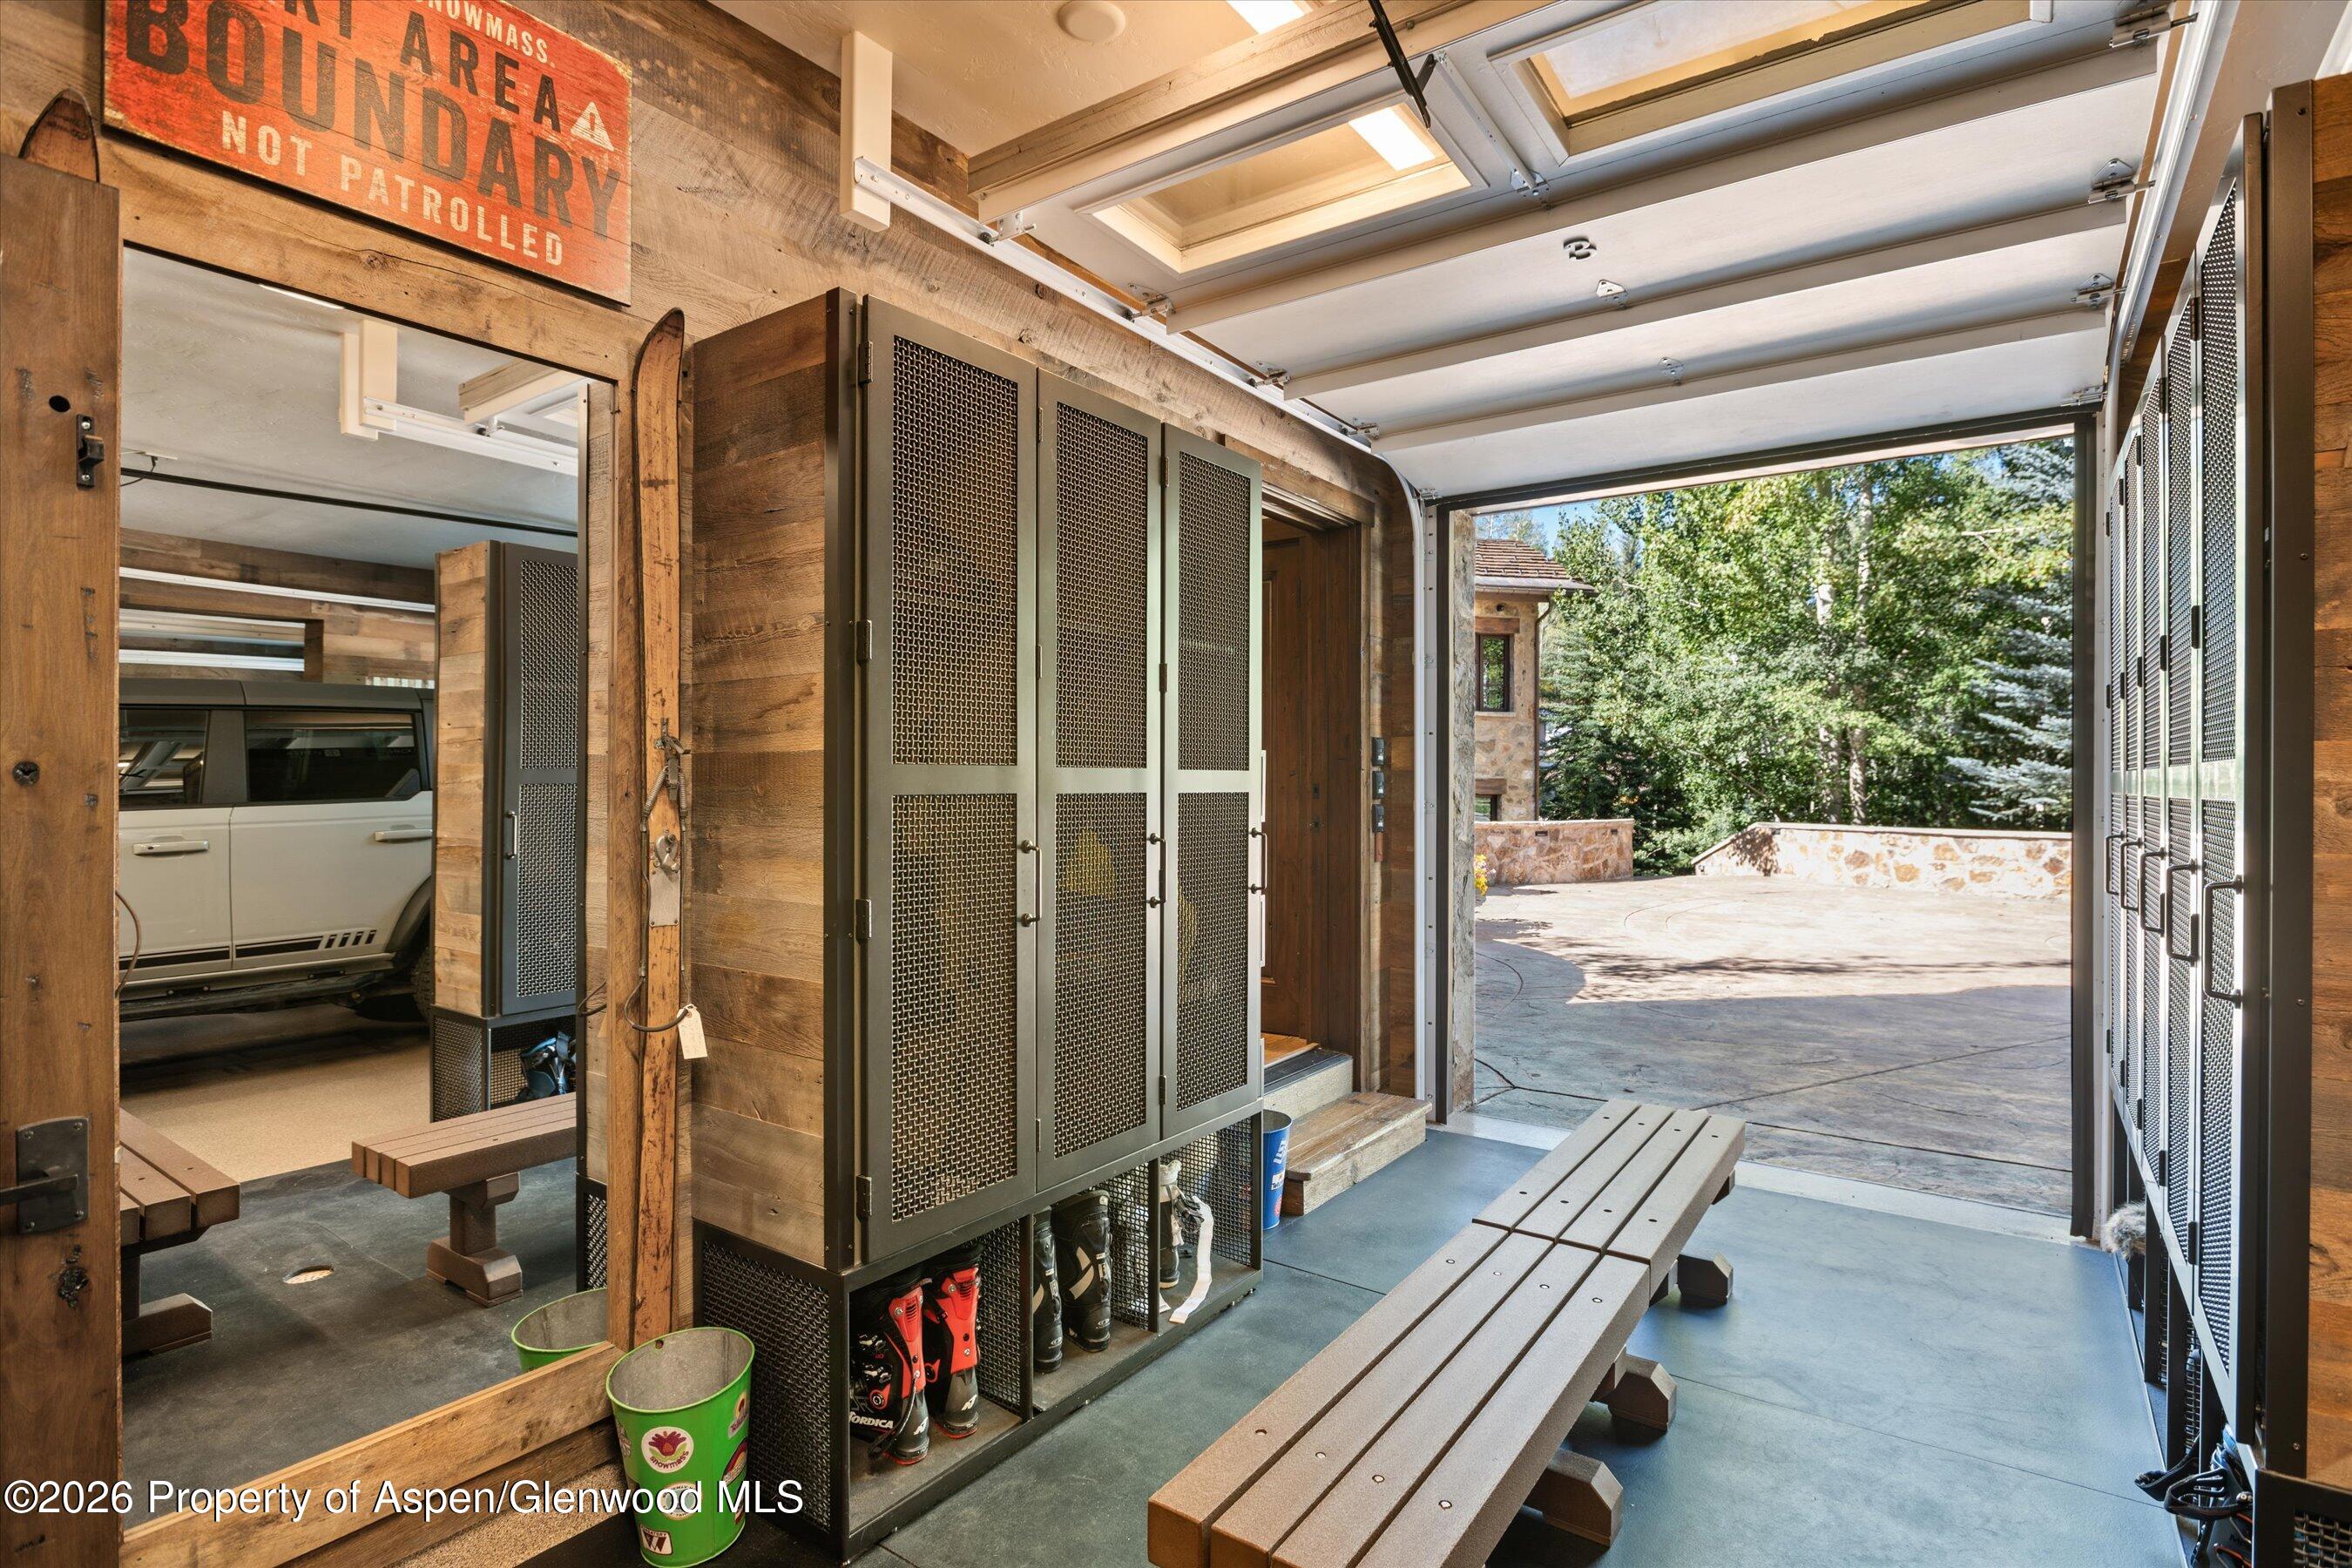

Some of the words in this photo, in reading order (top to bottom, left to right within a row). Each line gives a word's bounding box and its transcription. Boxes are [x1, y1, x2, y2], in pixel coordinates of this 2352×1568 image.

[400, 10, 561, 133] AREA
[415, 0, 557, 68] OWMASS.
[125, 0, 622, 243] BOUNDARY
[220, 110, 313, 177] NOT
[341, 157, 564, 267] PATROLLED
[649, 1450, 689, 1470] snowmass
